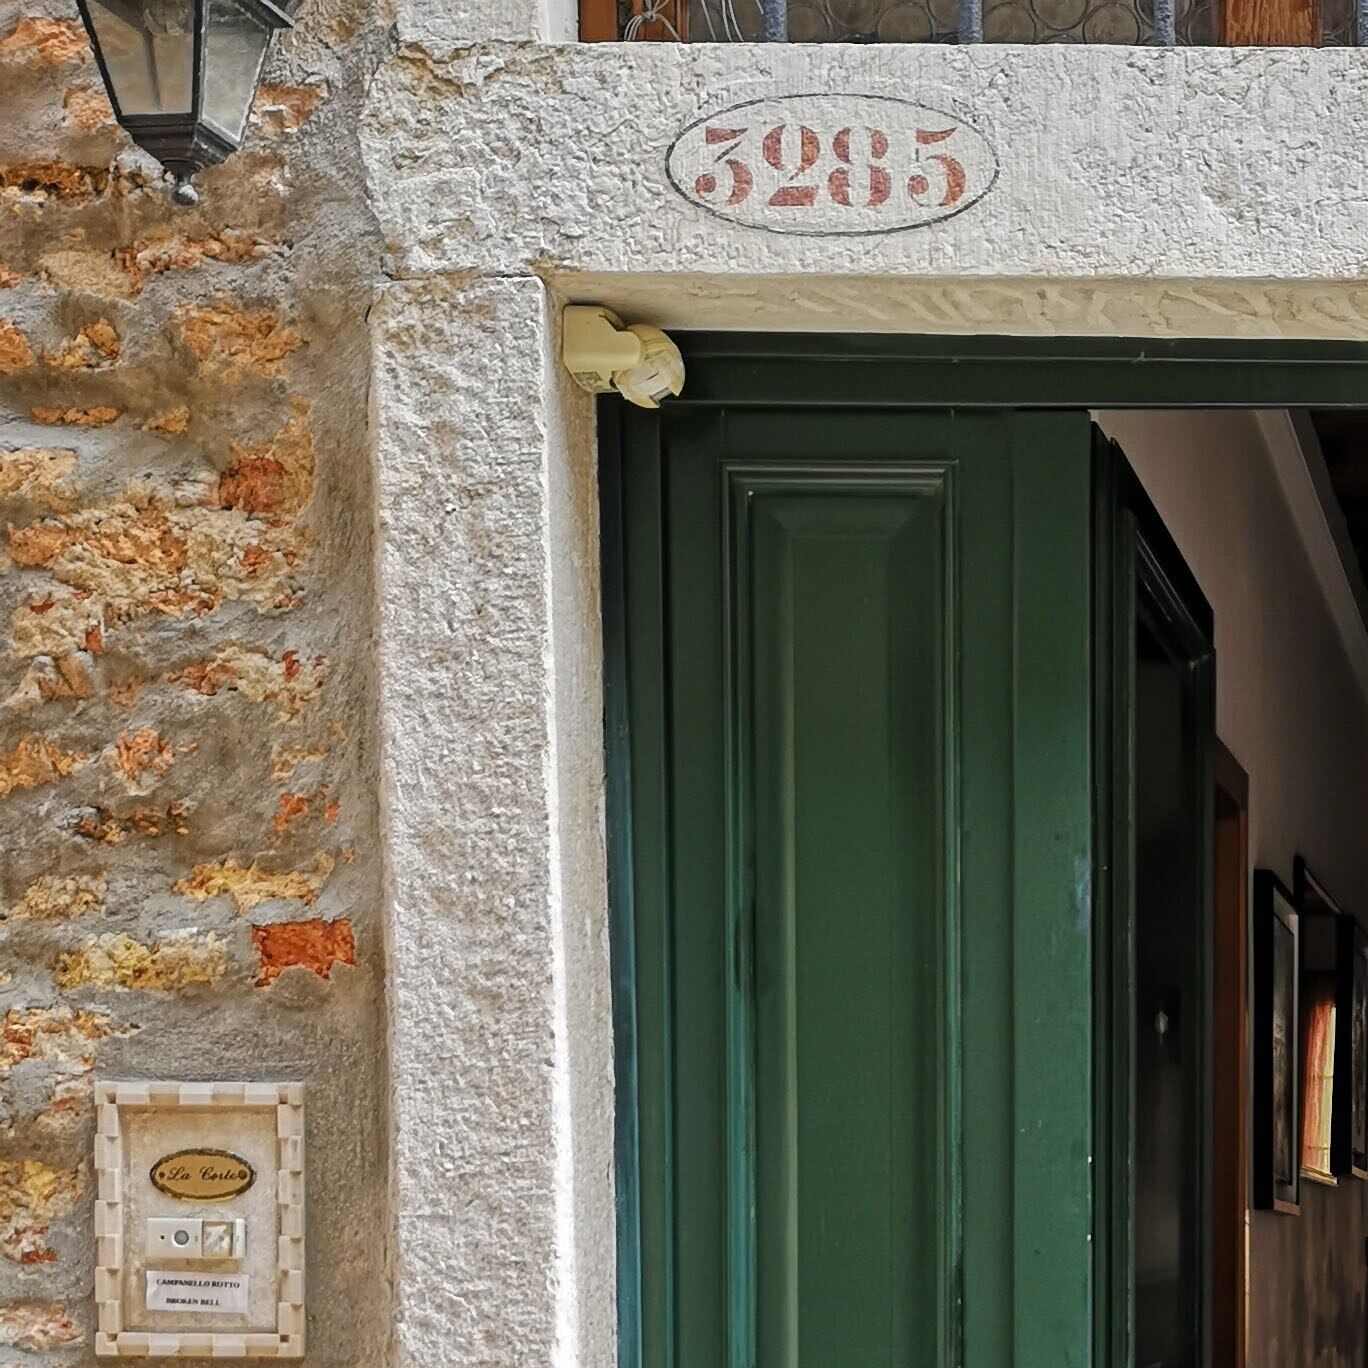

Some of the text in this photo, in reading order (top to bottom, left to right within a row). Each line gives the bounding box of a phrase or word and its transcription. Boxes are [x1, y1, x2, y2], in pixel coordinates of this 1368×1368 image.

[695, 123, 967, 208] 3285
[167, 1166, 192, 1181] La
[156, 1279, 210, 1287] CAMPANELLO
[200, 1298, 221, 1306] BELL
